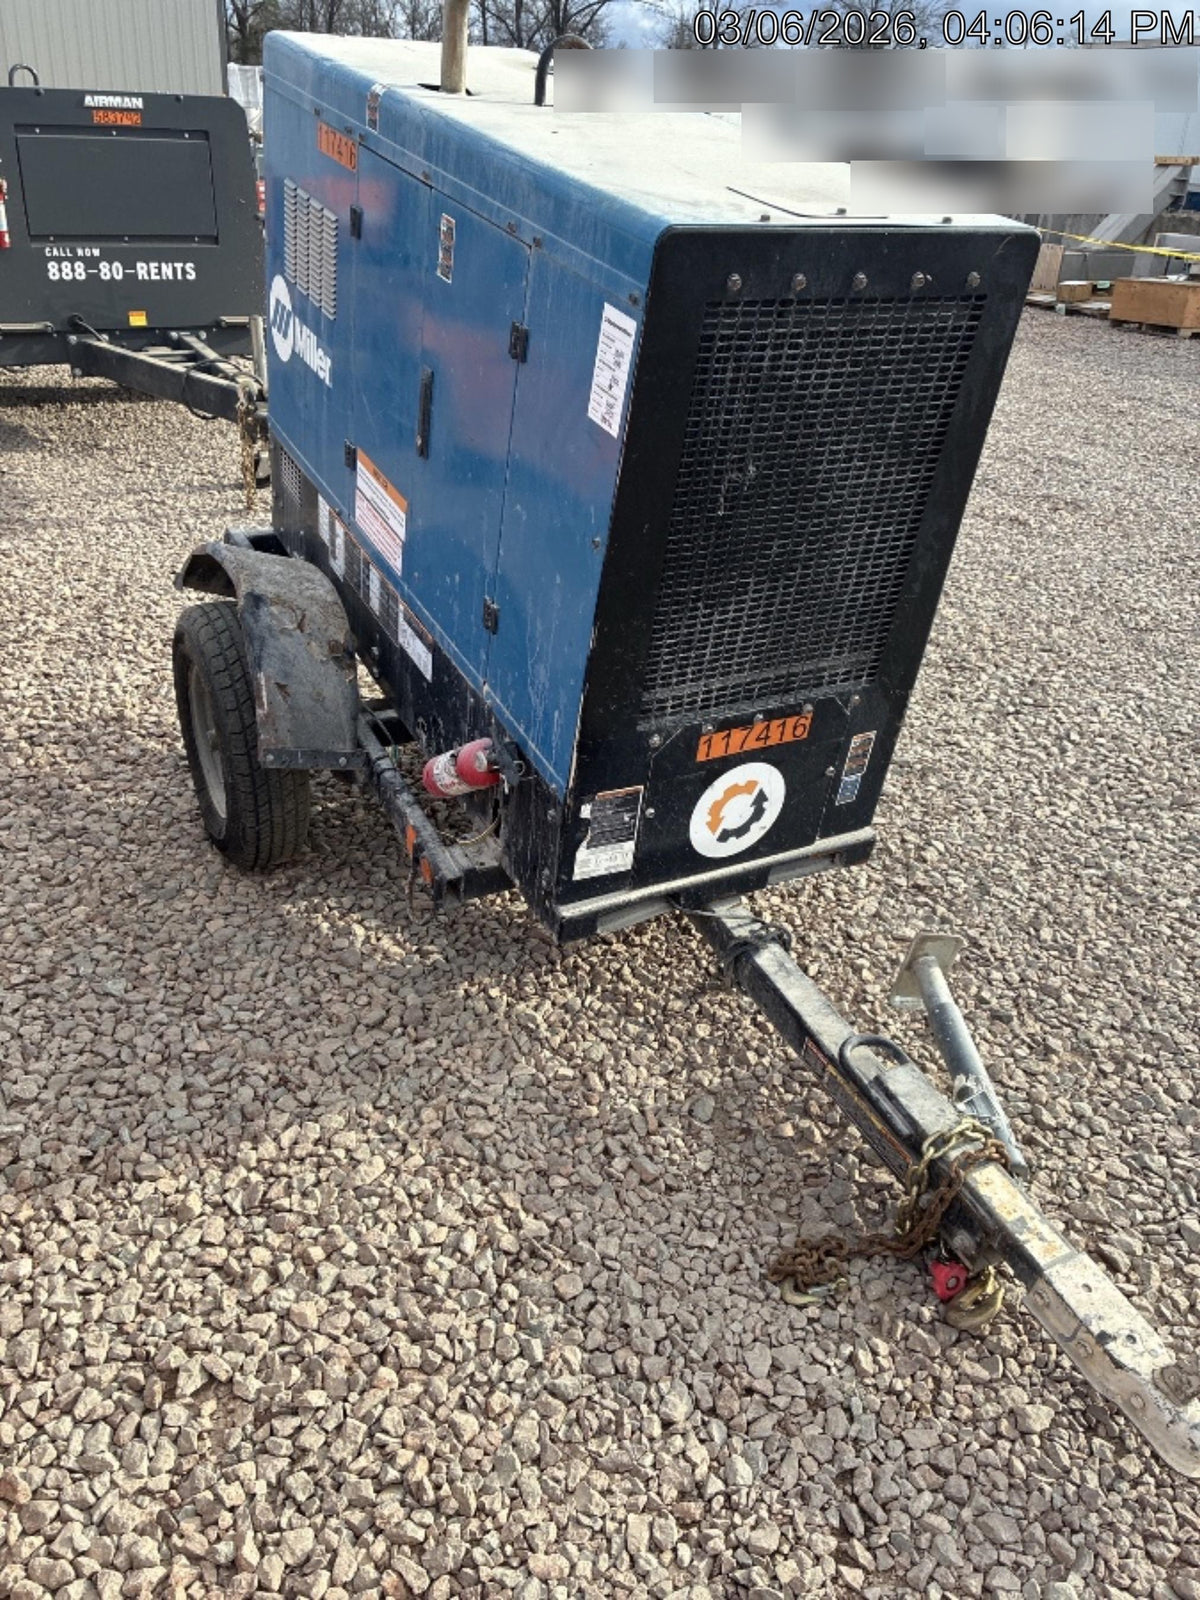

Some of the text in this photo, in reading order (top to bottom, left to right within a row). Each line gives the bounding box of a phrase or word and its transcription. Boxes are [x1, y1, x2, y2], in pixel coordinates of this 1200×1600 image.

[83, 94, 144, 109] AIRMAN
[318, 121, 357, 171] 117416
[45, 246, 101, 257] CALL NOW
[47, 260, 197, 281] 888-80-RENTS
[294, 315, 333, 388] Miller
[702, 715, 809, 758] 117416
